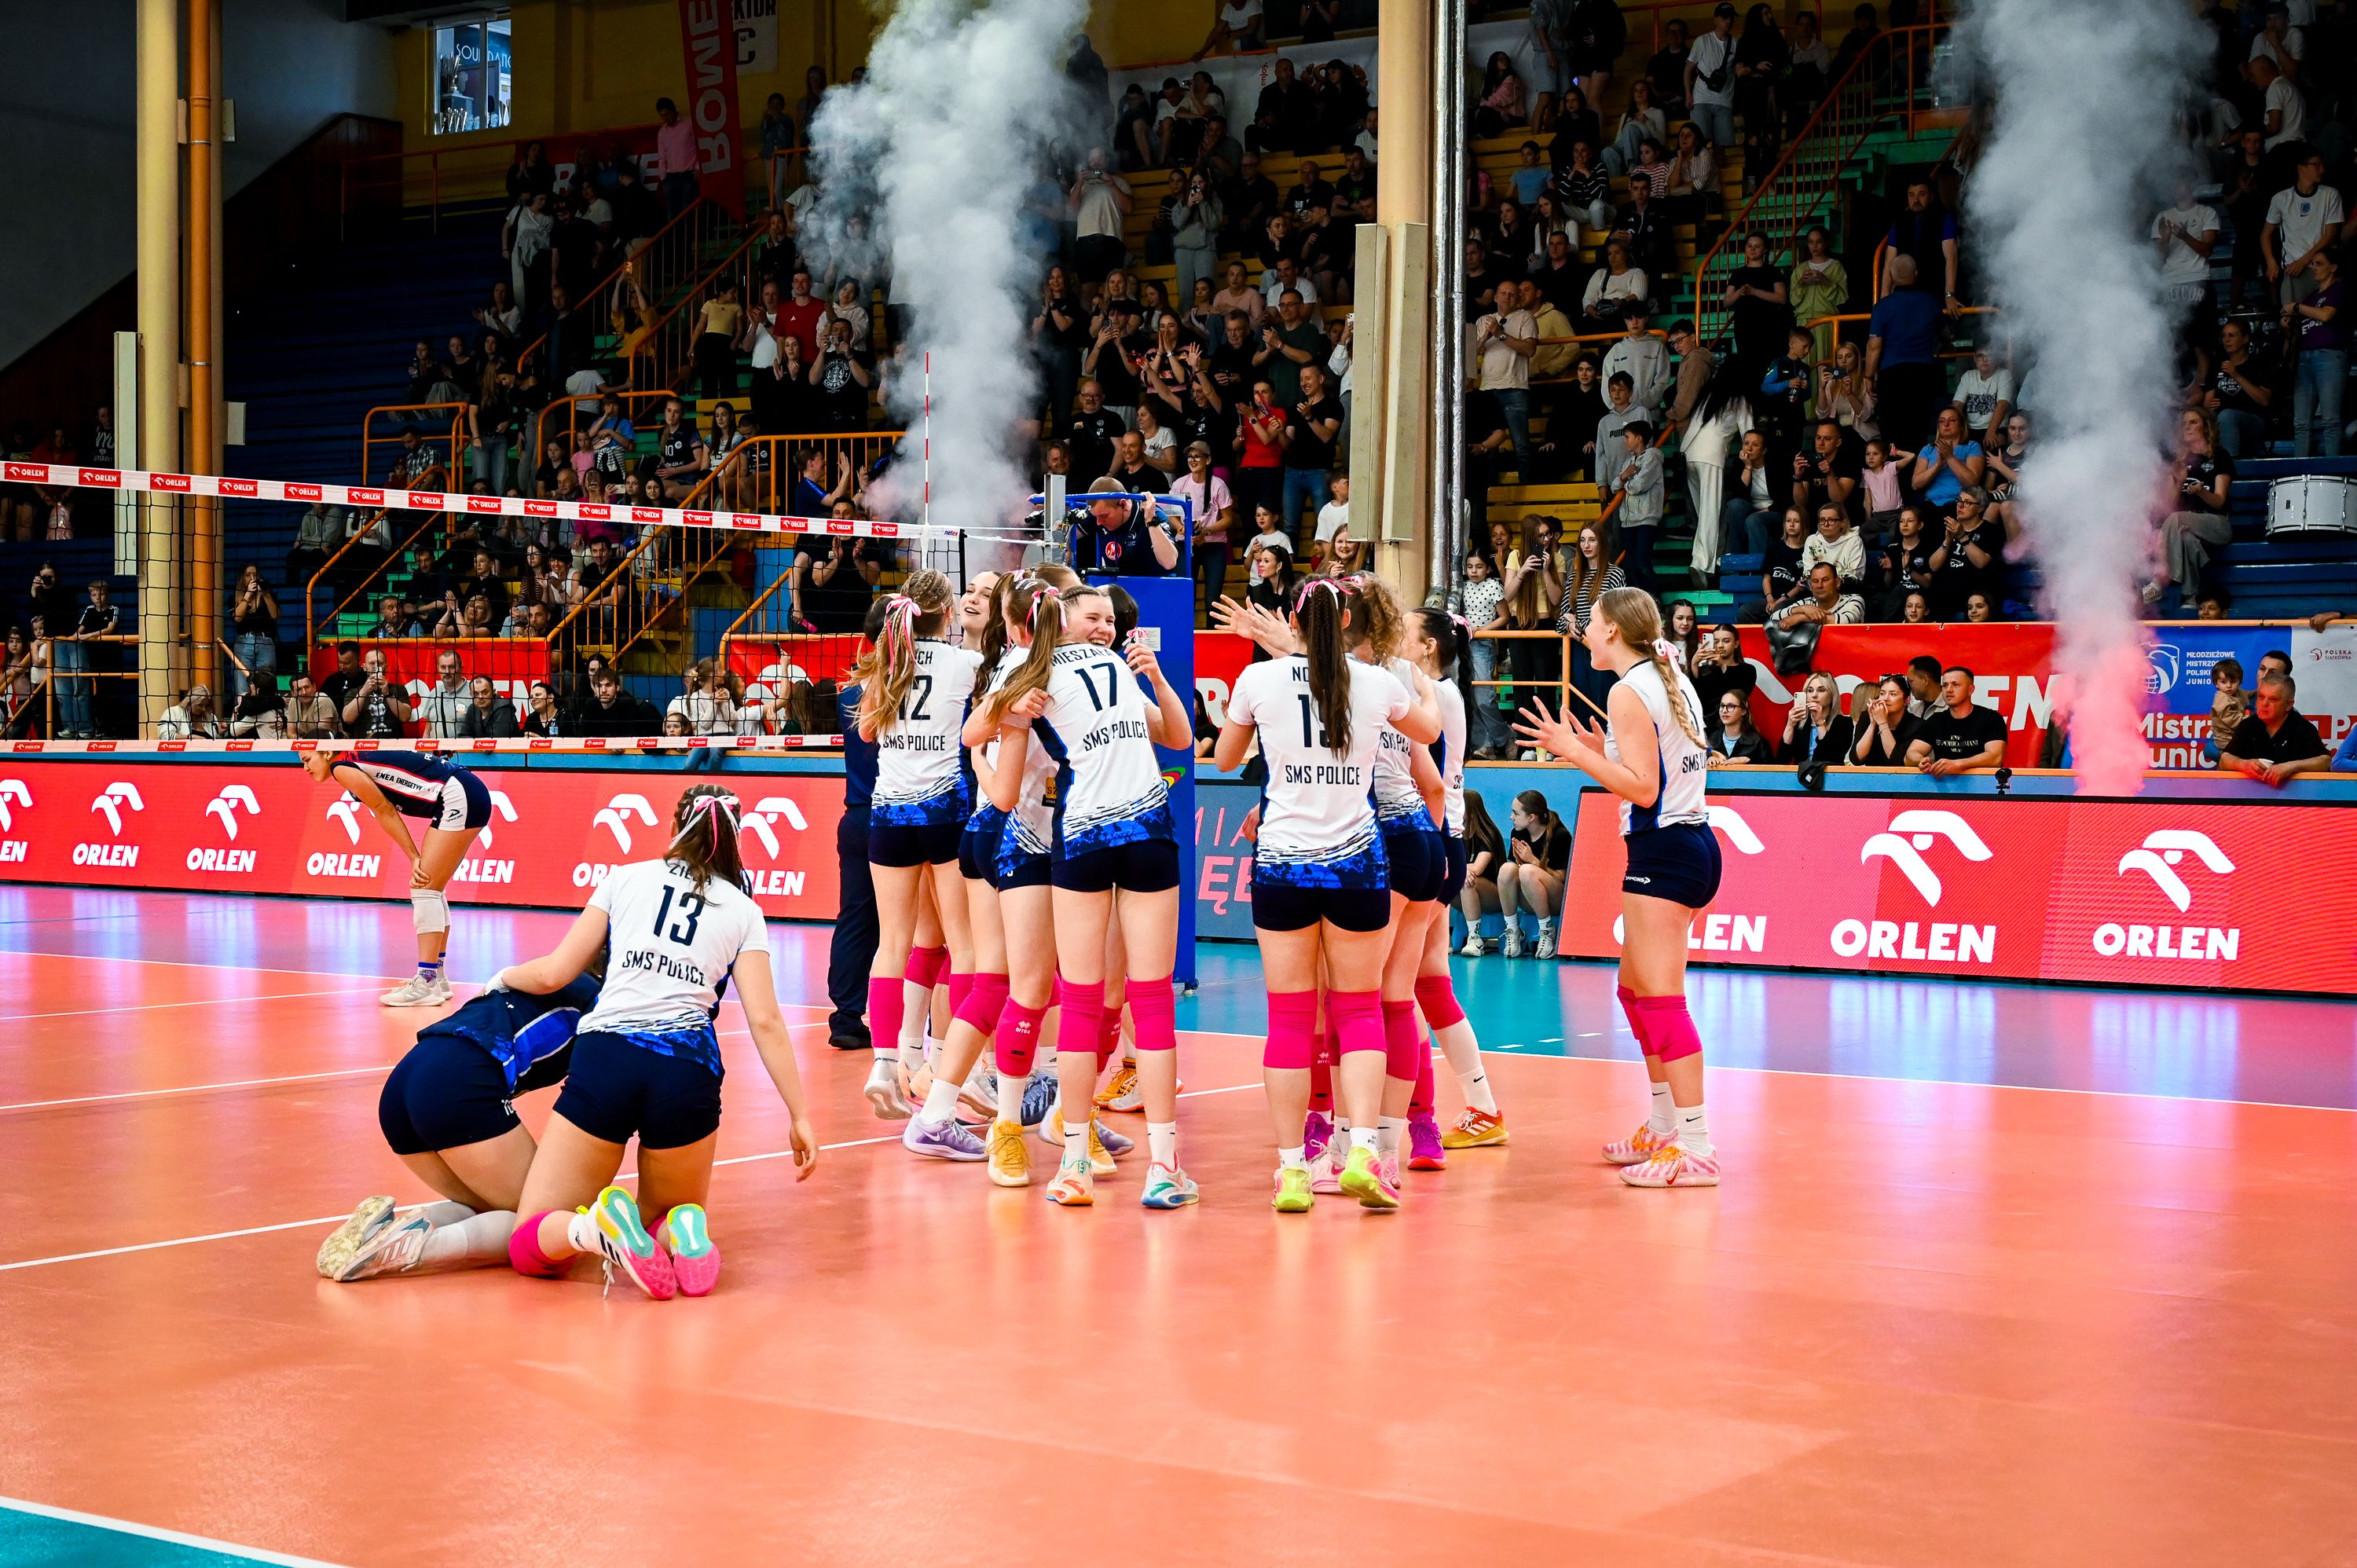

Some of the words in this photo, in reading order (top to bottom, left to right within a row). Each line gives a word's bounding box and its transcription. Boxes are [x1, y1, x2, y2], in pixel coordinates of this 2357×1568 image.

[823, 379, 845, 387] COFFEE
[1074, 661, 1117, 713] 17
[1083, 727, 1109, 752] SMS
[1111, 720, 1148, 739] POLICE
[2138, 712, 2213, 739] Mistrz
[882, 735, 904, 749] SMS
[907, 735, 946, 751] POLICE
[376, 772, 394, 782] ENEA
[1285, 765, 1312, 784] SMS
[1317, 766, 1360, 786] POLICE
[1682, 753, 1699, 774] SMS
[72, 843, 139, 867] ORLEN
[186, 847, 257, 873] ORLEN
[306, 852, 380, 877] ORLEN
[452, 858, 515, 884] RLEN
[741, 869, 805, 896] RLEN
[653, 885, 706, 947] 13
[1831, 919, 1996, 963] ORLEN
[2093, 922, 2240, 961] ORLEN
[622, 950, 654, 970] SMS
[657, 954, 706, 987] POLICE
